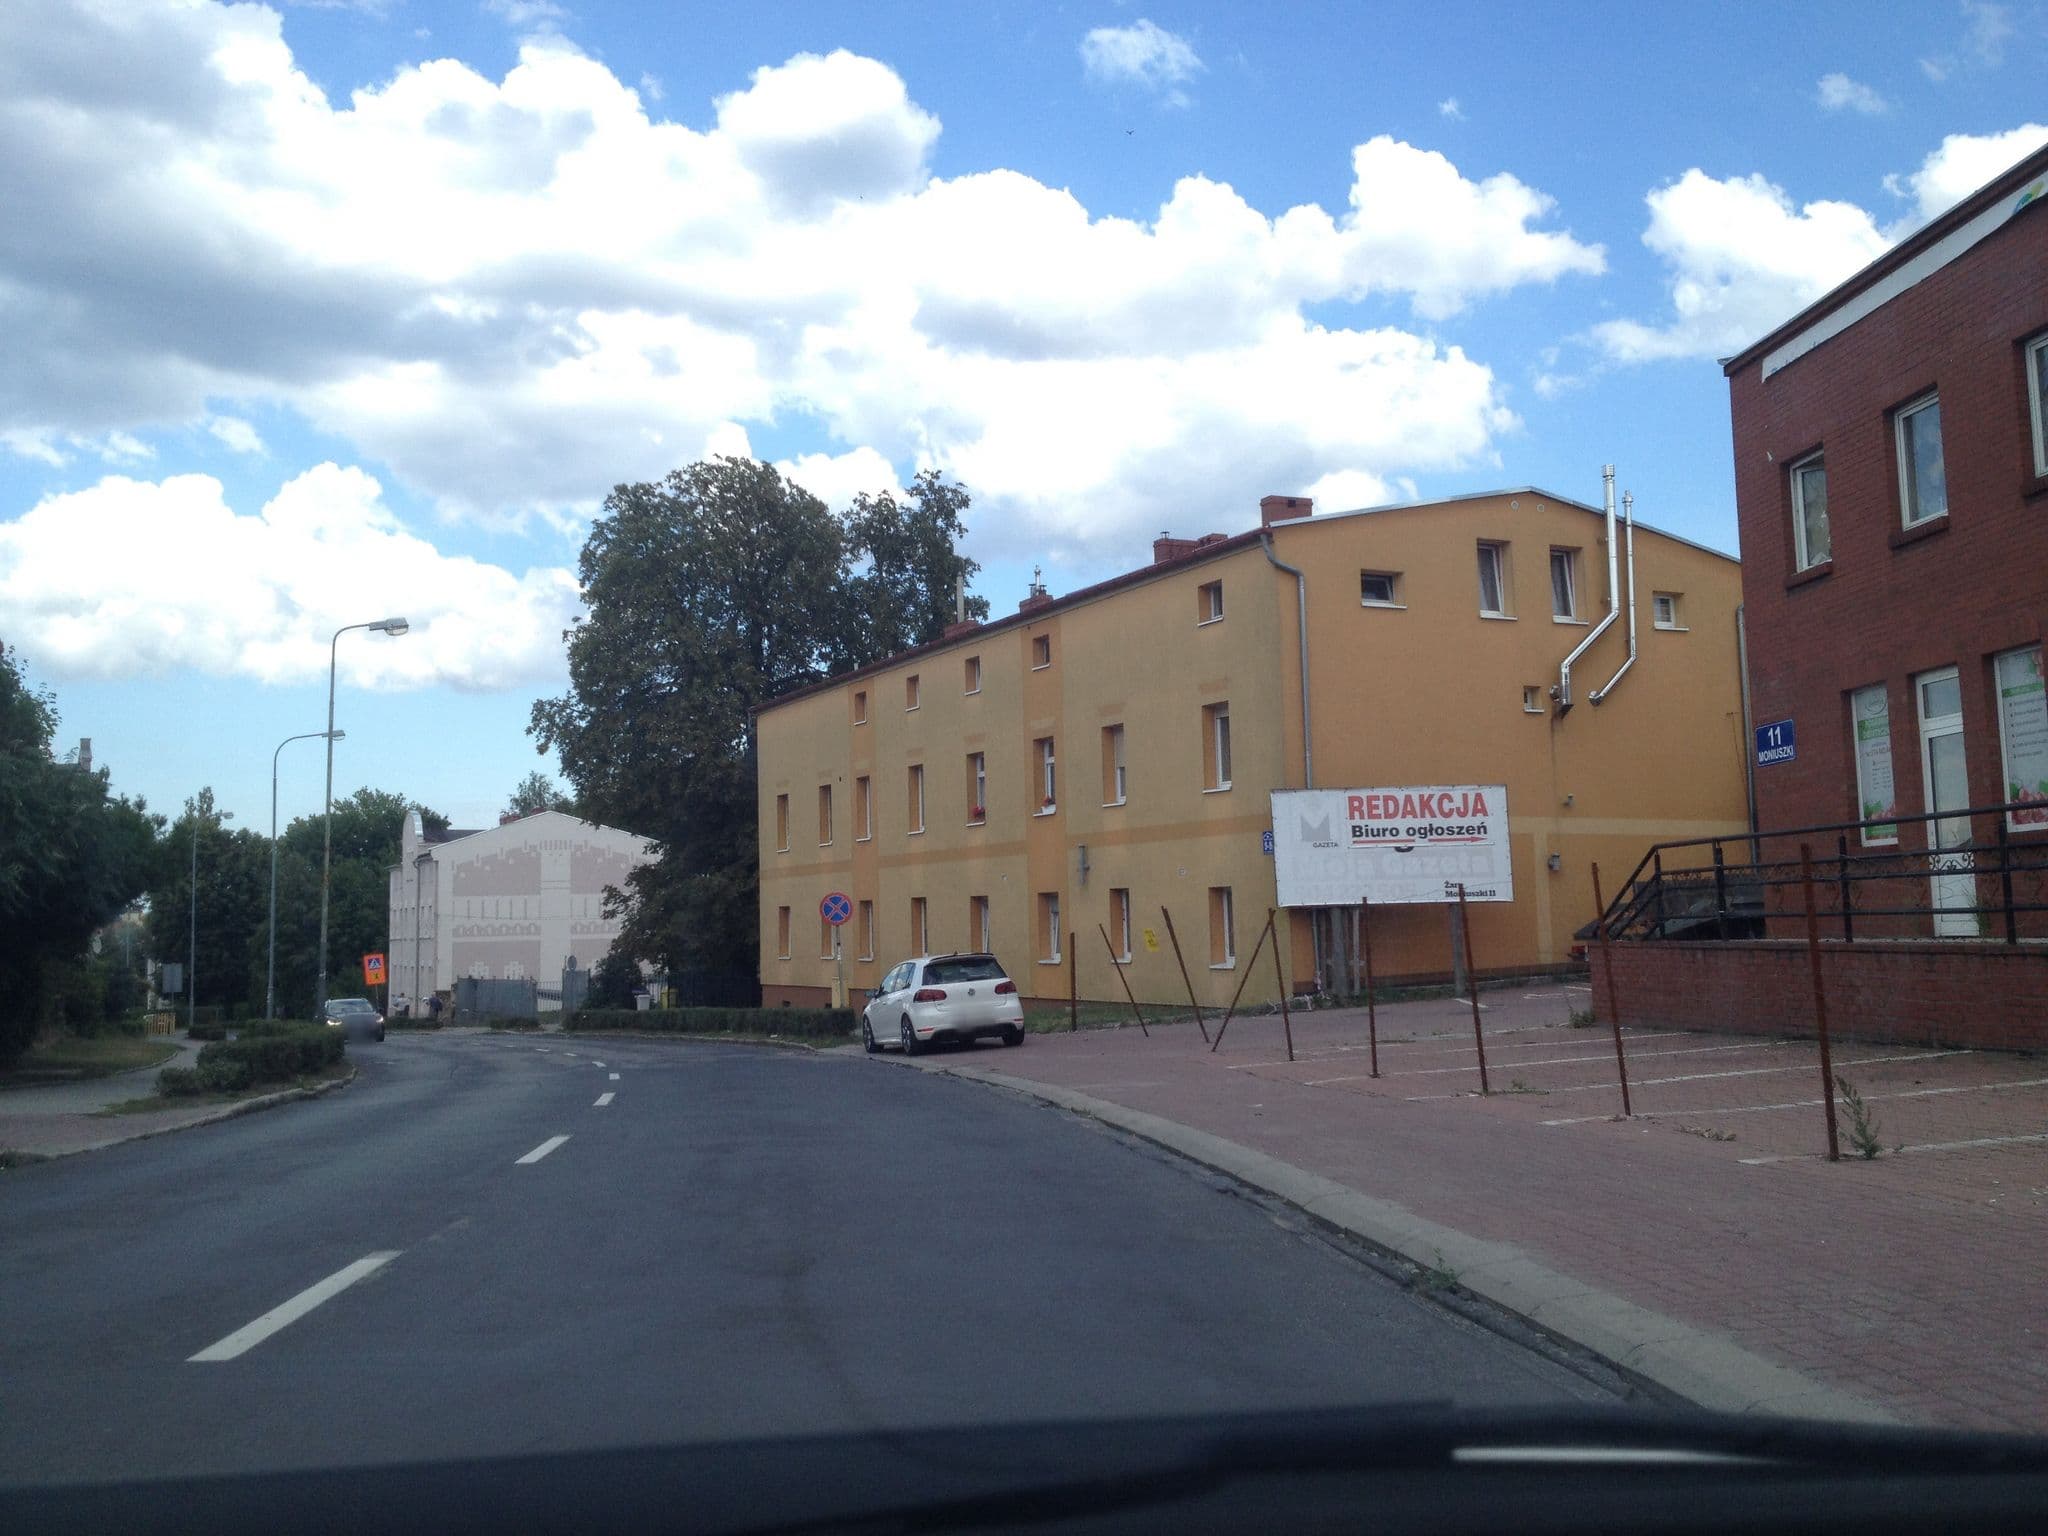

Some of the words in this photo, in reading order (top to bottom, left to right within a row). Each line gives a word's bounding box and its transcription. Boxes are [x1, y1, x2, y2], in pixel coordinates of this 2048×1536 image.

[1767, 726, 1781, 747] 11
[1758, 745, 1794, 762] MONIUSZKI
[1348, 793, 1488, 820] REDAKCJA
[1352, 825, 1400, 838] Biuro
[1406, 822, 1487, 839] ogłoszeń
[1444, 880, 1463, 889] Żar
